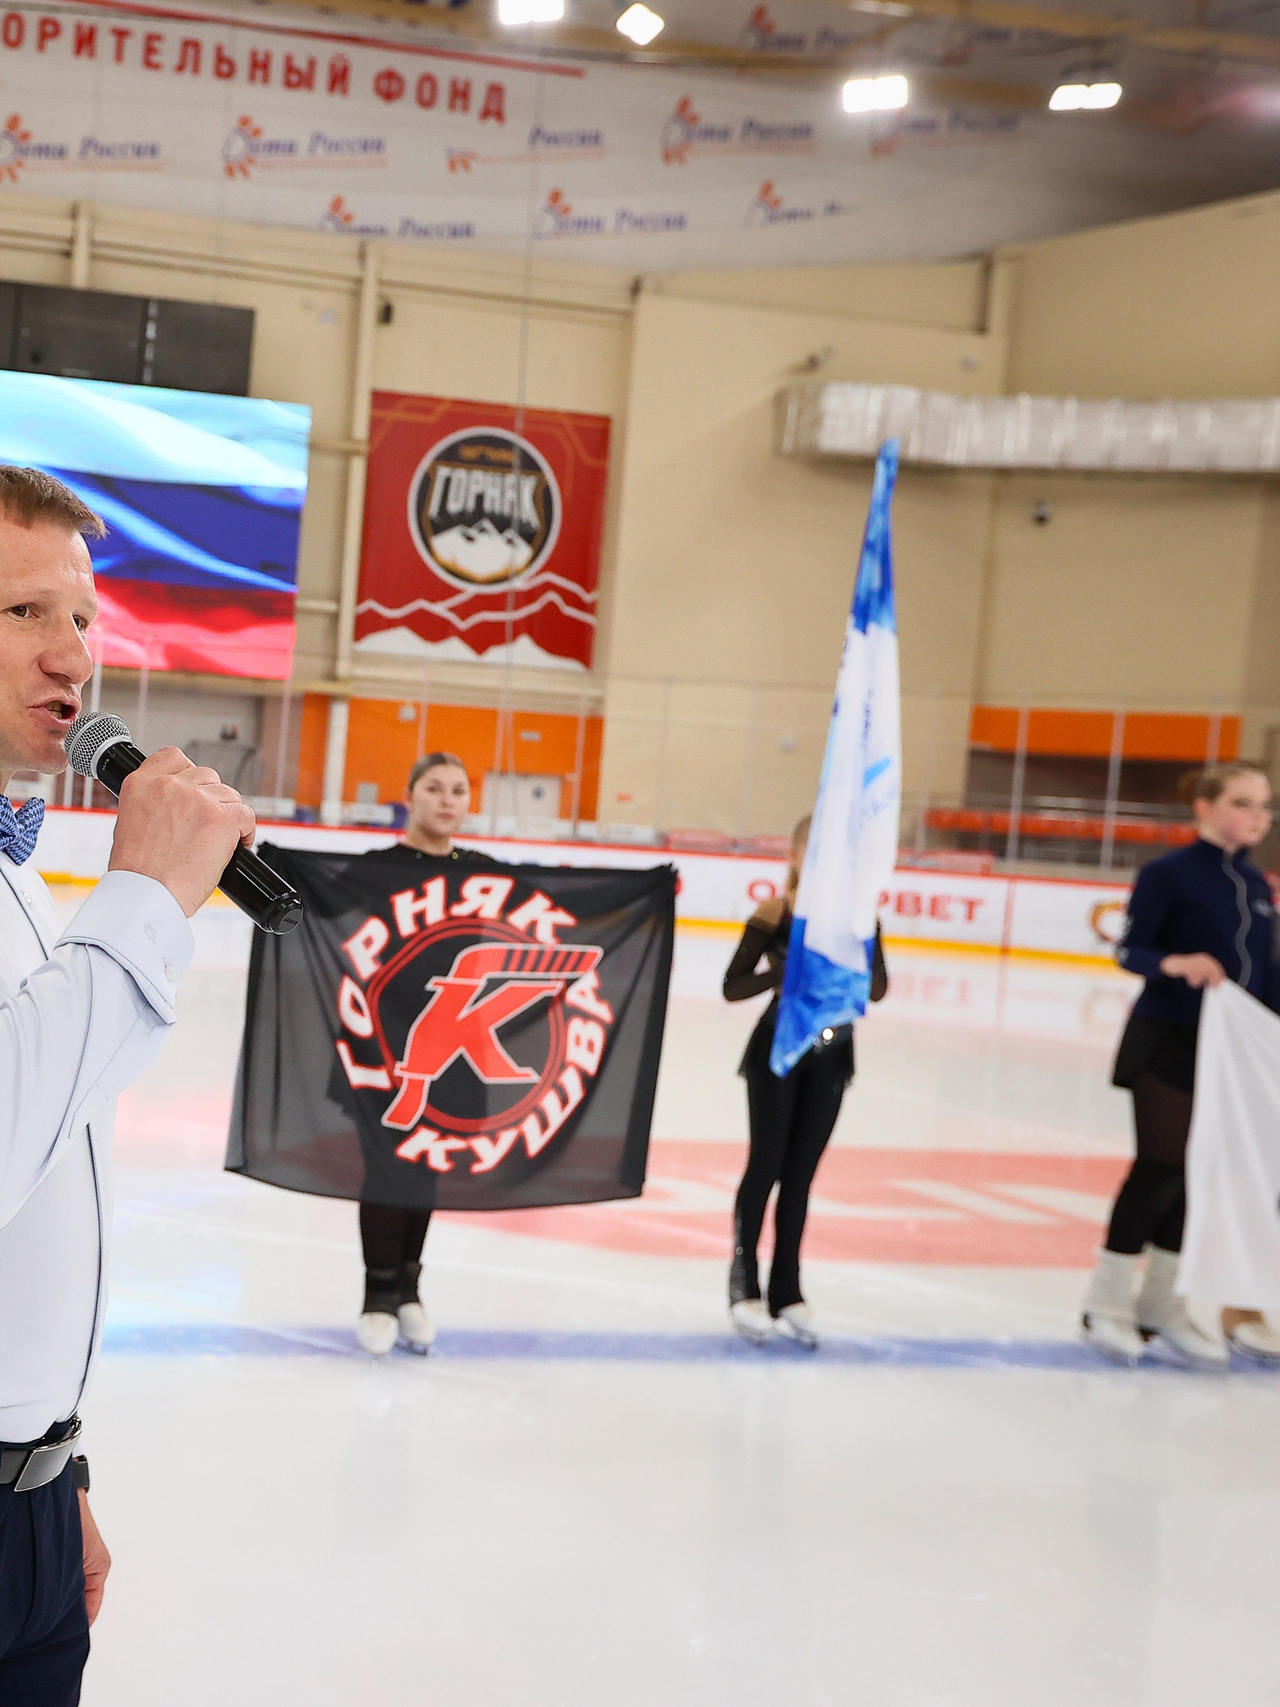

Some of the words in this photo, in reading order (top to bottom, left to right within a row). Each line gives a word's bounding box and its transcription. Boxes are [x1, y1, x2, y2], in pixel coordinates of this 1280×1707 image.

[372, 65, 507, 125] ФОНД
[428, 464, 541, 534] ГОРНЯК
[336, 874, 578, 1091] ГОРНЯК
[394, 968, 616, 1174] КУШВА
